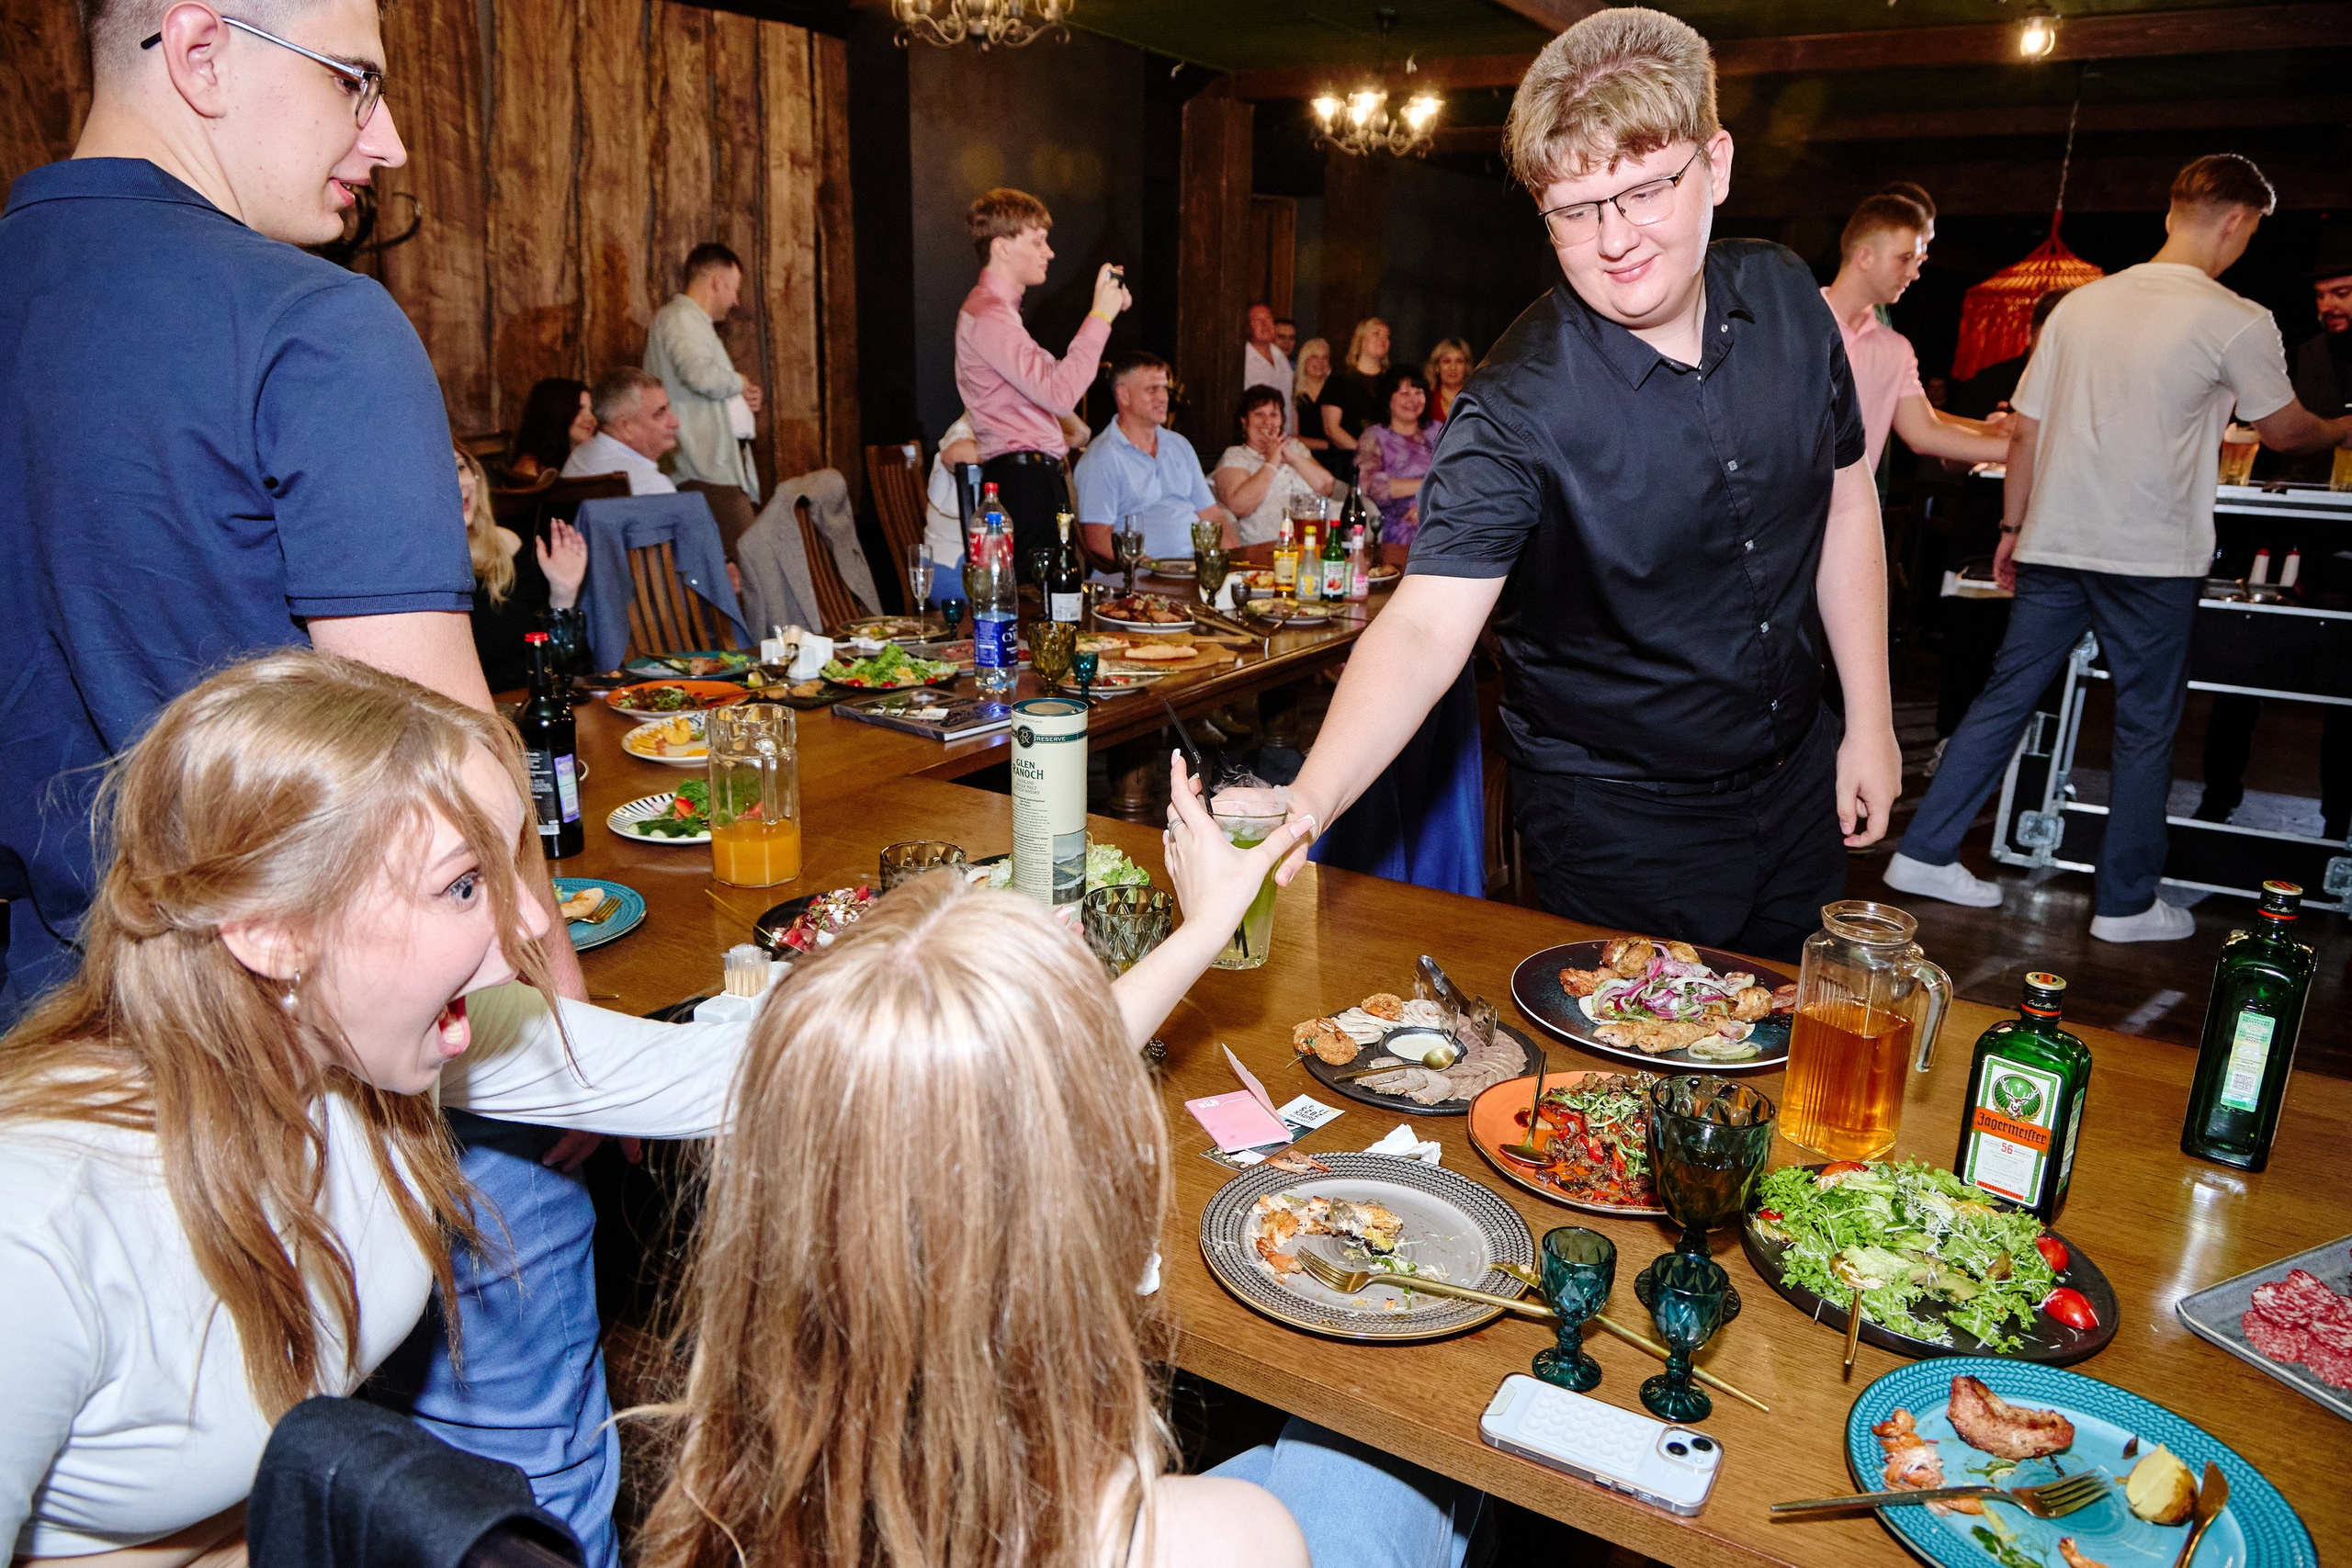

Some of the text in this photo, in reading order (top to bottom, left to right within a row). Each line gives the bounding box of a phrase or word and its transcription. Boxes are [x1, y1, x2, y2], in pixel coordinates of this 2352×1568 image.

[1016, 758, 1035, 769] GLEN
[1012, 763, 1043, 779] RANOCH
[2001, 1142, 2013, 1154] 56
